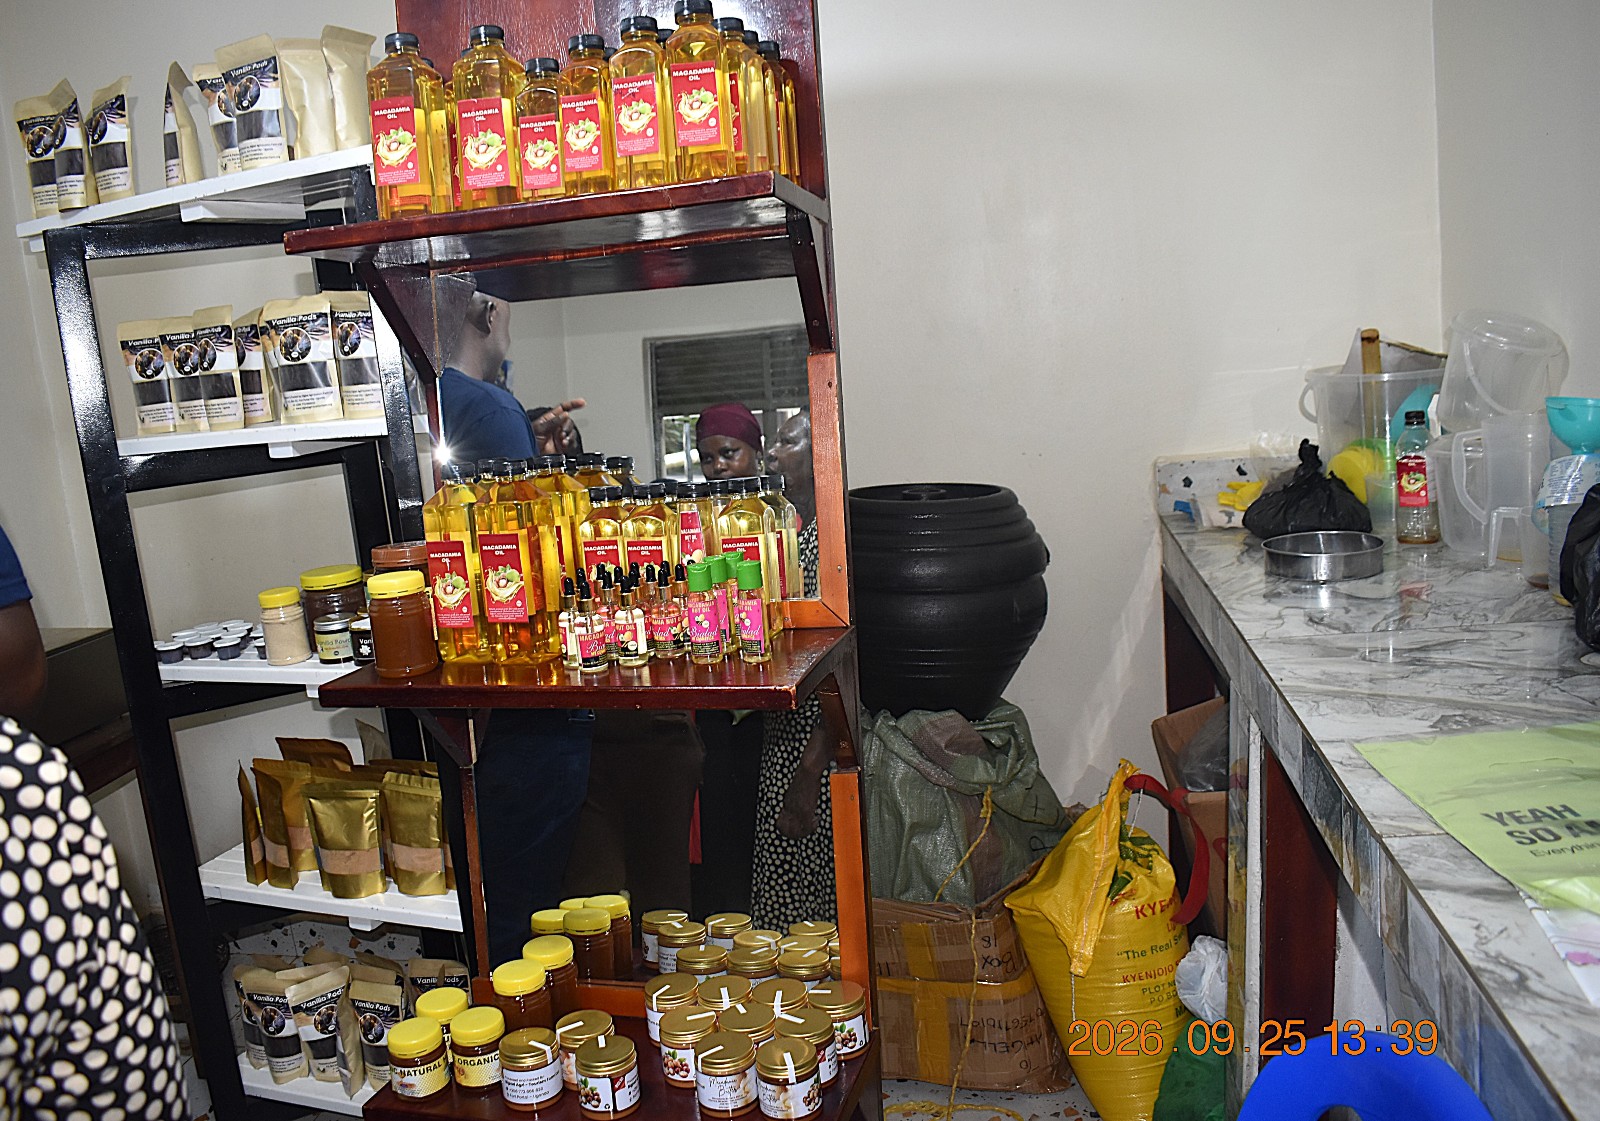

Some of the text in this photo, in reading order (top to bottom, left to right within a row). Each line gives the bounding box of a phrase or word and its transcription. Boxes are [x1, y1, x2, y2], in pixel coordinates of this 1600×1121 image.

[672, 67, 715, 76] MACADAMIA
[614, 80, 652, 90] MACADAMIA
[562, 99, 598, 108] MACADAMIA
[374, 106, 410, 116] MACADAMIA
[462, 108, 499, 118] MACADAMIA
[520, 120, 556, 128] MACADAMIA
[272, 314, 317, 326] Vanilla Pods
[723, 542, 758, 550] MACADAMIA
[1480, 804, 1582, 826] YEAH
[1506, 826, 1562, 846] SO
[1151, 939, 1172, 954] Real
[982, 951, 1016, 974] Box
[1122, 964, 1174, 984] KYENJOJO
[1142, 984, 1165, 996] PLOT
[253, 994, 274, 1002] Vanilla
[301, 996, 326, 1009] Vanilla
[355, 1000, 390, 1012] Vanilla Pods
[457, 1053, 500, 1066] ORGANIC
[400, 1062, 442, 1077] NATURAL
